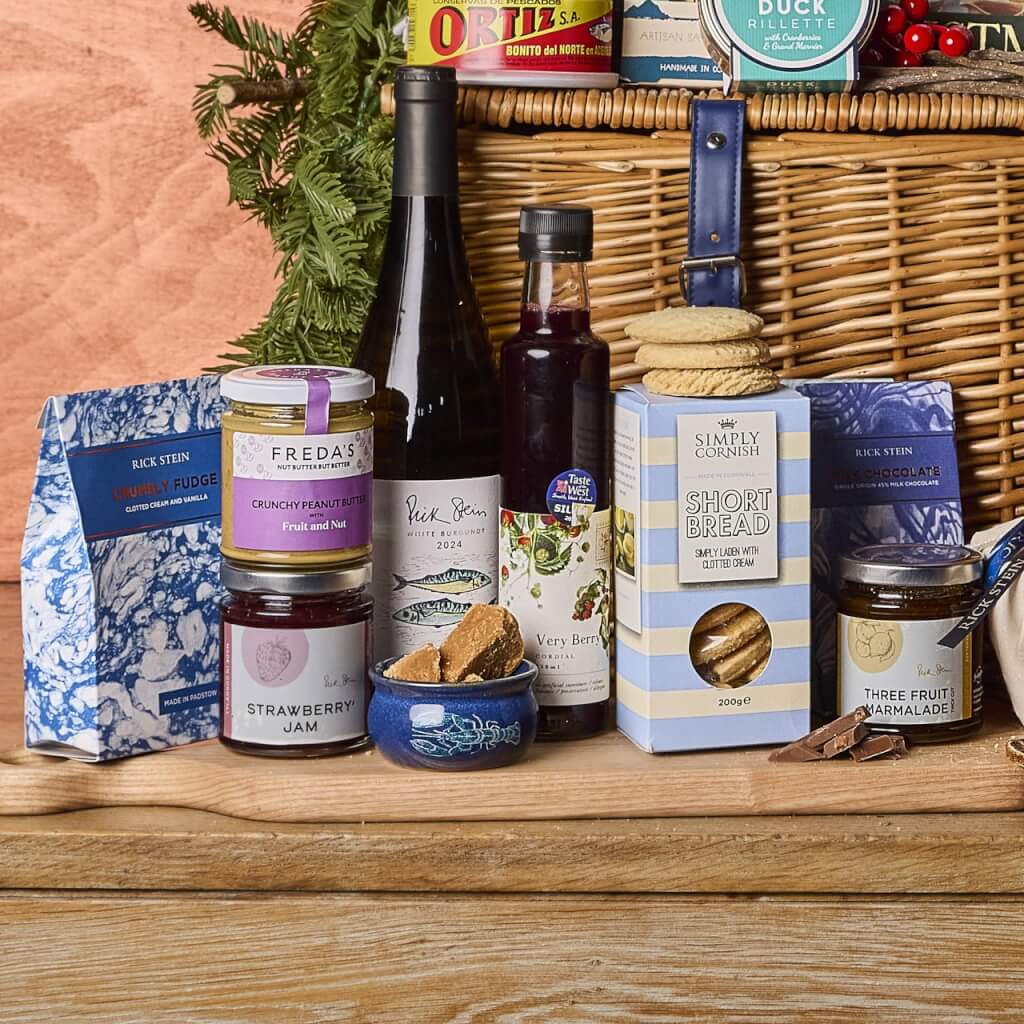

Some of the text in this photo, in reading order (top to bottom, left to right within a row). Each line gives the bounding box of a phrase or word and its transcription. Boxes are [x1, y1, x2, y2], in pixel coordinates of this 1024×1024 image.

[748, 18, 837, 29] RILLETTE
[429, 5, 556, 57] ORTIZ
[506, 44, 542, 56] BONITO
[543, 44, 558, 56] del
[559, 44, 585, 55] NORTE
[695, 431, 760, 447] SIMPLY
[272, 443, 354, 461] FREDA'S
[695, 445, 760, 459] CORNISH
[855, 447, 913, 457] RICK STEIN
[132, 451, 190, 469] RICK STEIN
[318, 462, 331, 470] BUT
[864, 465, 941, 479] CHOCOLATE
[174, 472, 217, 490] FUDGE
[568, 473, 591, 486] Taste
[904, 479, 939, 487] CHOCOLATE
[568, 485, 590, 497] West
[125, 503, 149, 513] CLOTTED
[252, 494, 367, 510] CRUNCHY PEANUT BUTTER
[685, 488, 772, 514] SHORT
[282, 519, 347, 532] Fruit and Nut
[686, 513, 770, 539] BREAD
[437, 540, 462, 550] 2024
[732, 558, 754, 568] CREAM
[959, 597, 992, 631] RICK
[537, 633, 600, 649] Very Berry
[865, 687, 949, 701] THREE FRUIT
[247, 699, 355, 717] STRAWBERRY
[865, 703, 948, 717] MARMALADE
[283, 721, 318, 734] JAM
